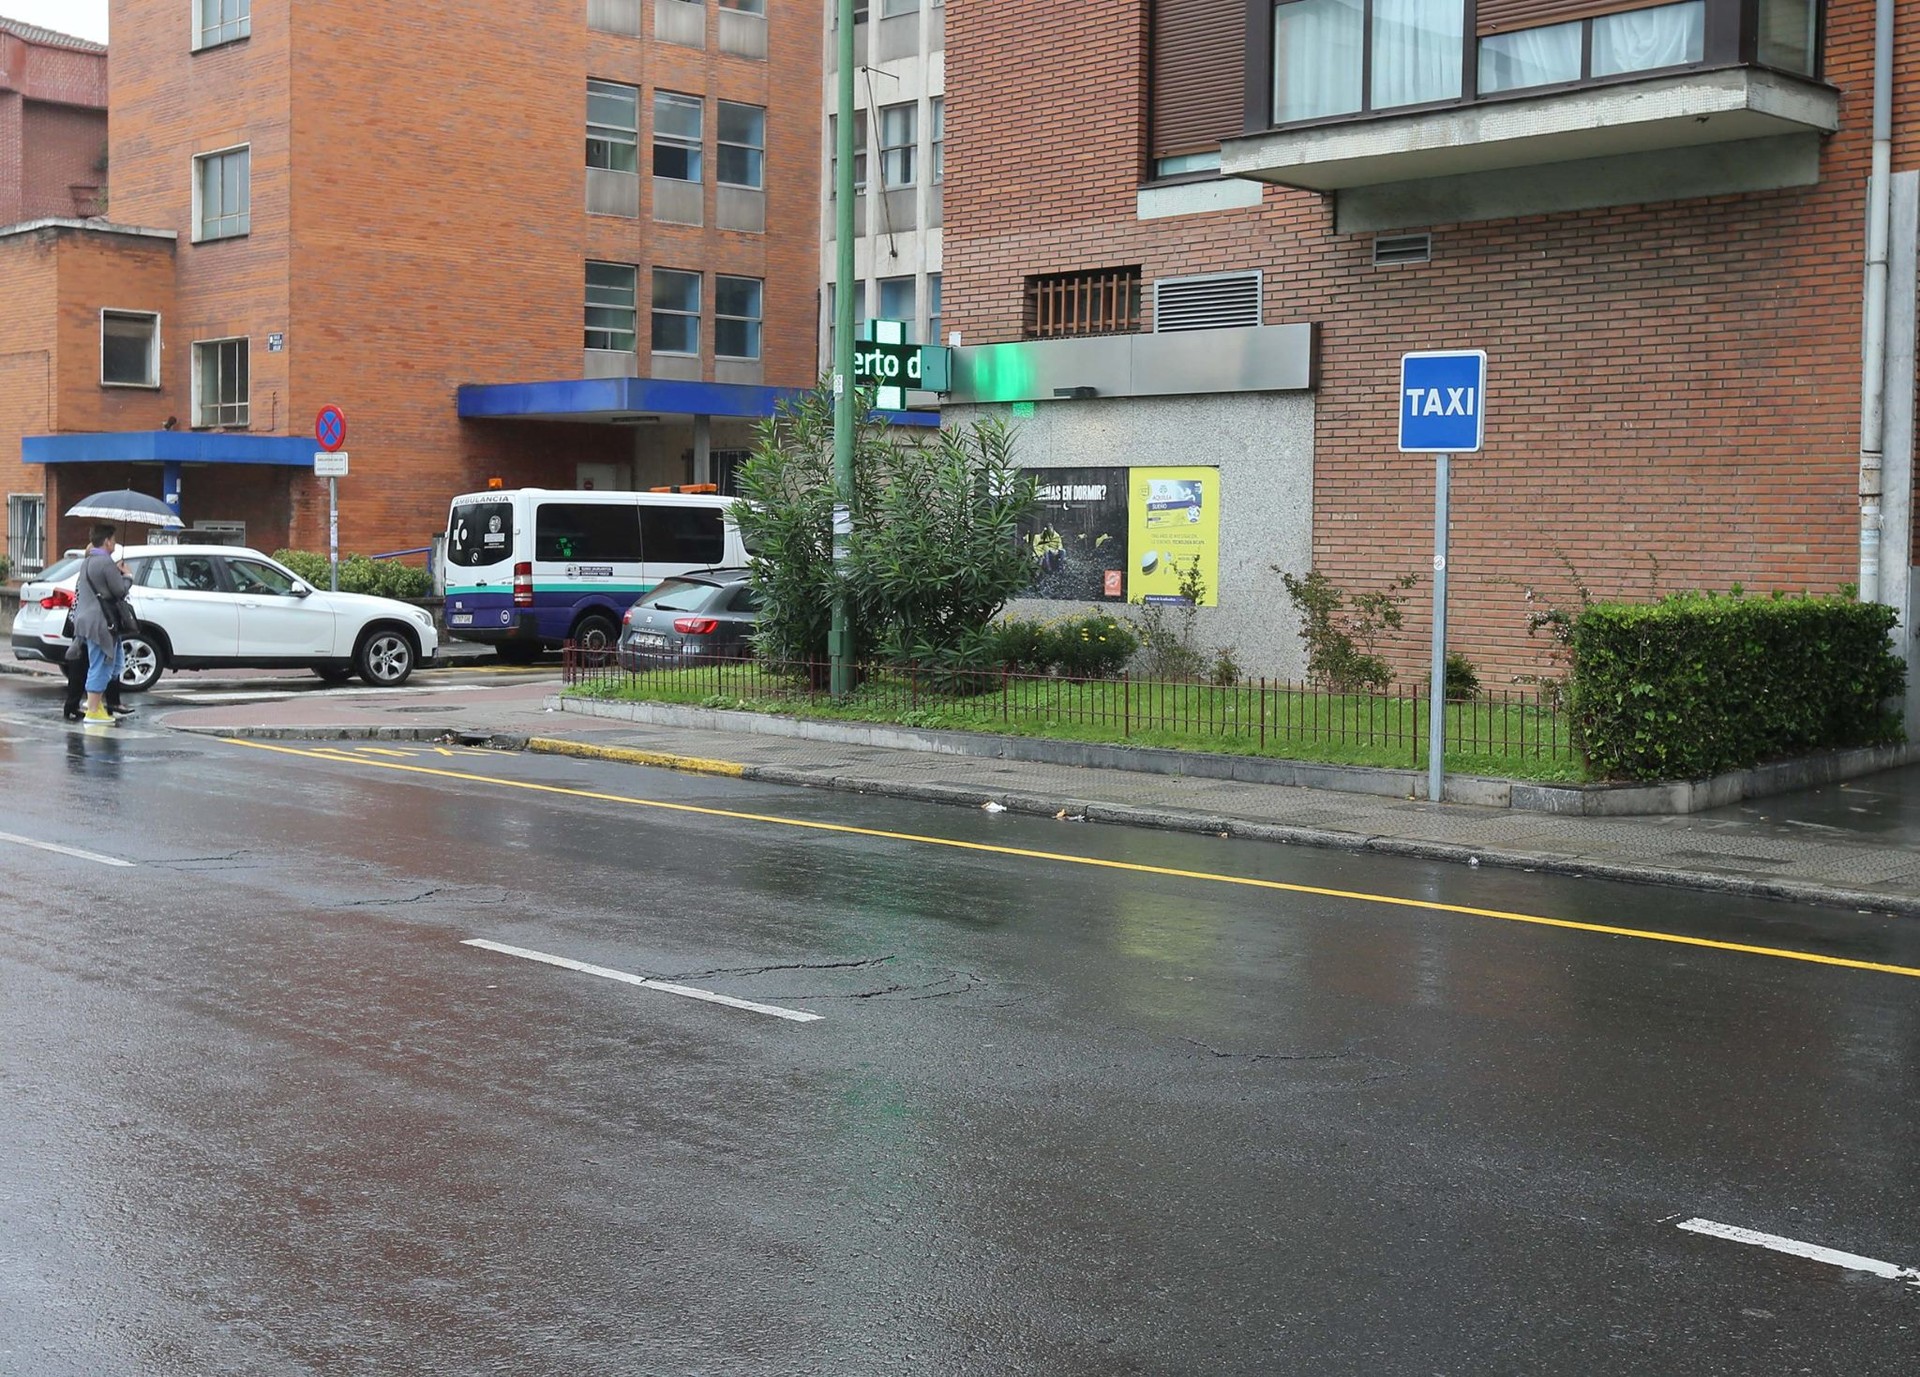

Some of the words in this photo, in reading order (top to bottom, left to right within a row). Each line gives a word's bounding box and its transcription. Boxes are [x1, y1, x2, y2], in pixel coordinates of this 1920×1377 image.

[1406, 387, 1474, 416] TAXI
[1062, 485, 1072, 500] EN
[1073, 485, 1106, 500] DORMIR?
[454, 496, 509, 505] AMBULANCIA
